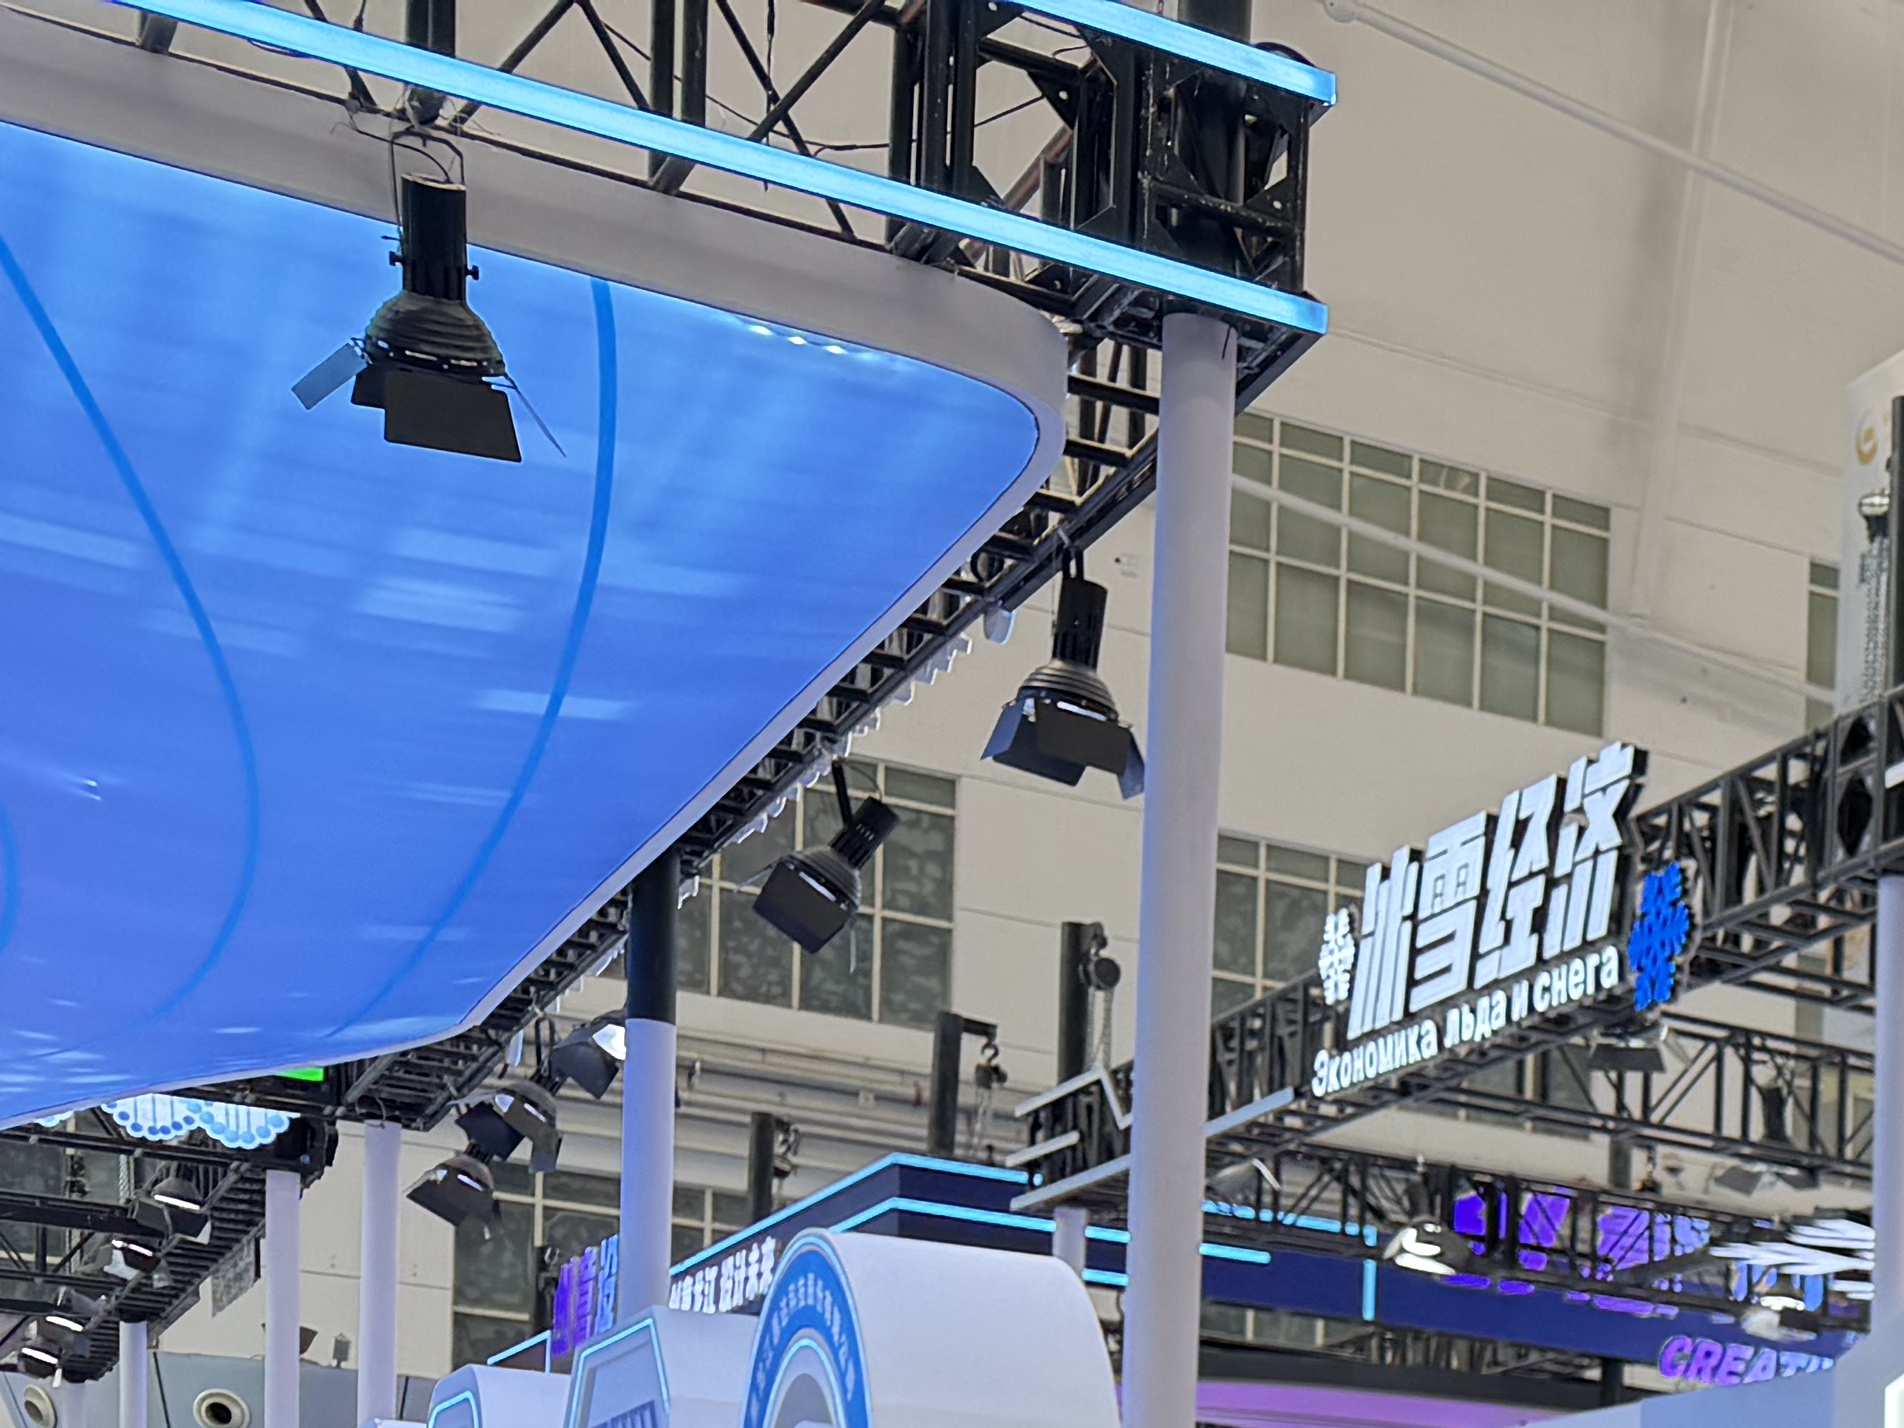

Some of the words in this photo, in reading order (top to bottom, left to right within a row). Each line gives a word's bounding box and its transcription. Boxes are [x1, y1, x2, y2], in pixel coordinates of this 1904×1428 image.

[1347, 741, 1635, 1041] 冰雪经济
[1311, 1018, 1438, 1099] Экономика
[1443, 988, 1507, 1049] льда
[1511, 979, 1528, 1023] и
[1532, 945, 1620, 1013] снега
